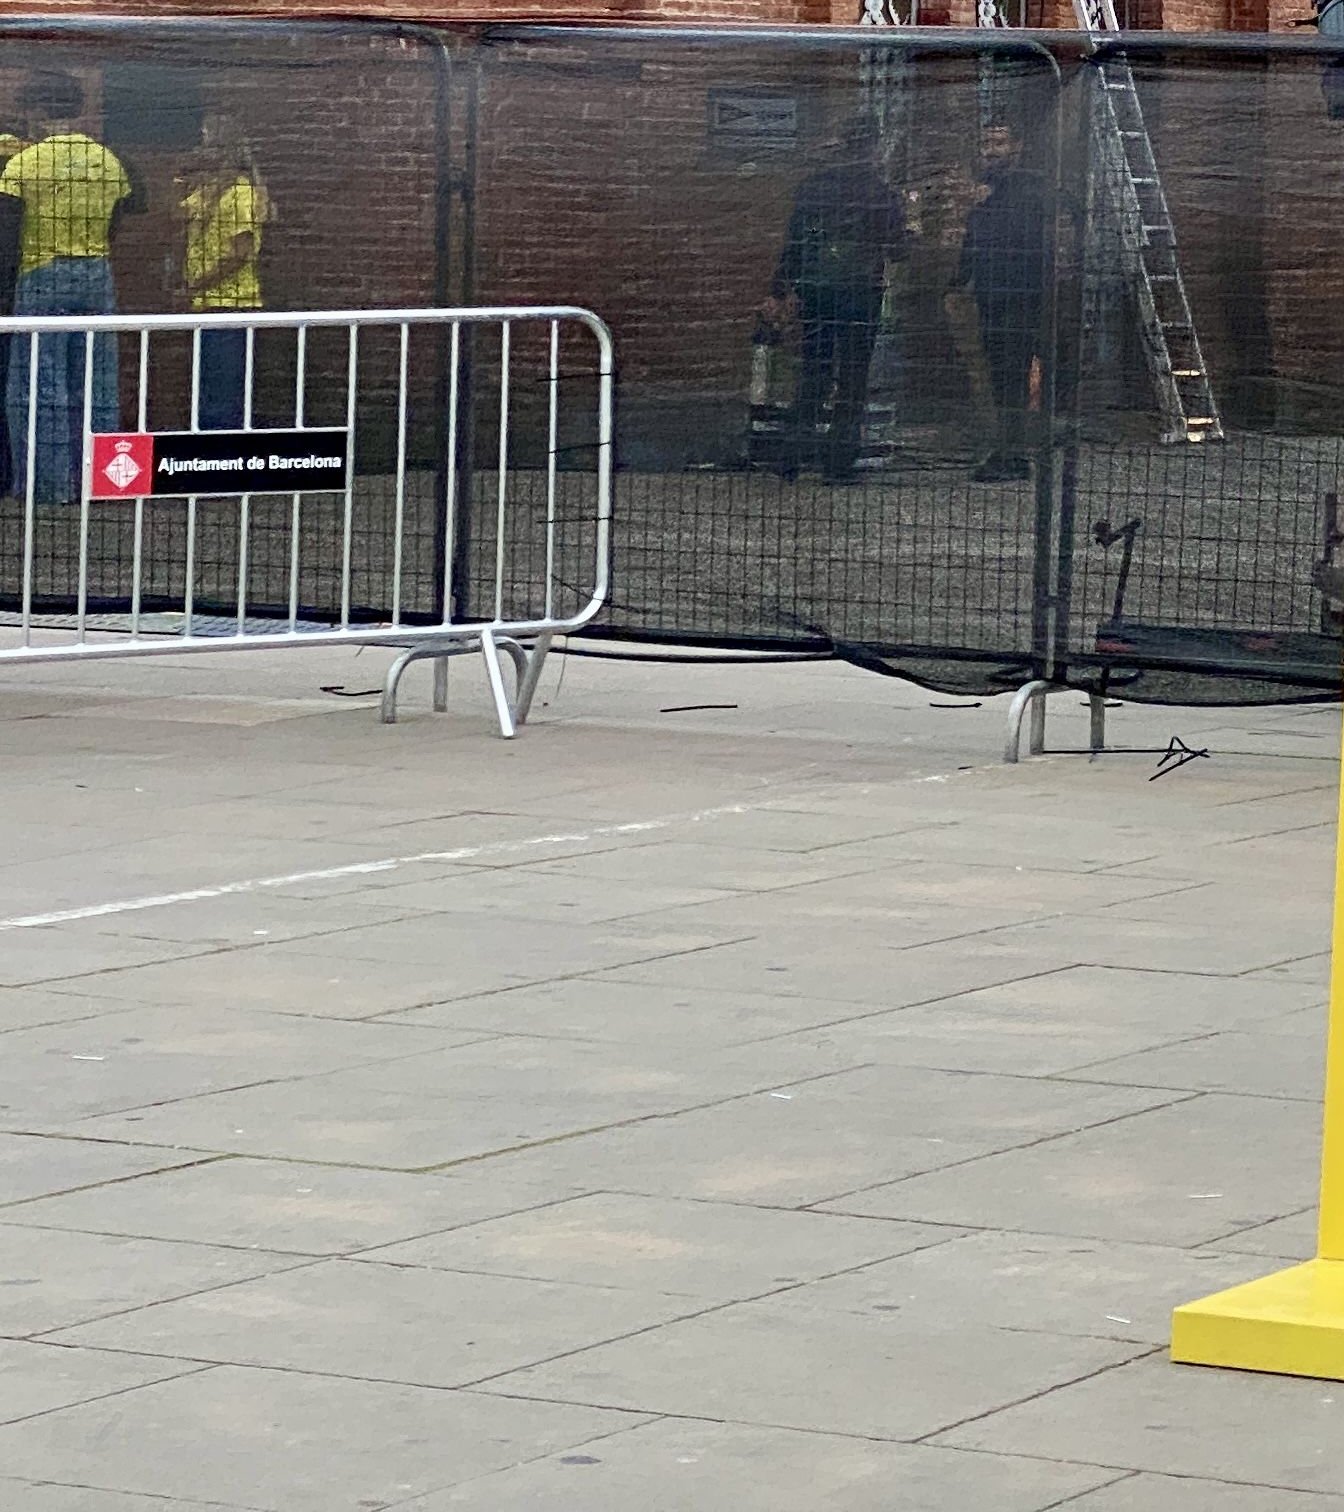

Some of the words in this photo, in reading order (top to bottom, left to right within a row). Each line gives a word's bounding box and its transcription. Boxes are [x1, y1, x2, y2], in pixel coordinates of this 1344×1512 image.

[157, 456, 244, 476] Ajuntament
[246, 455, 265, 471] de
[268, 454, 342, 471] Barcelona
